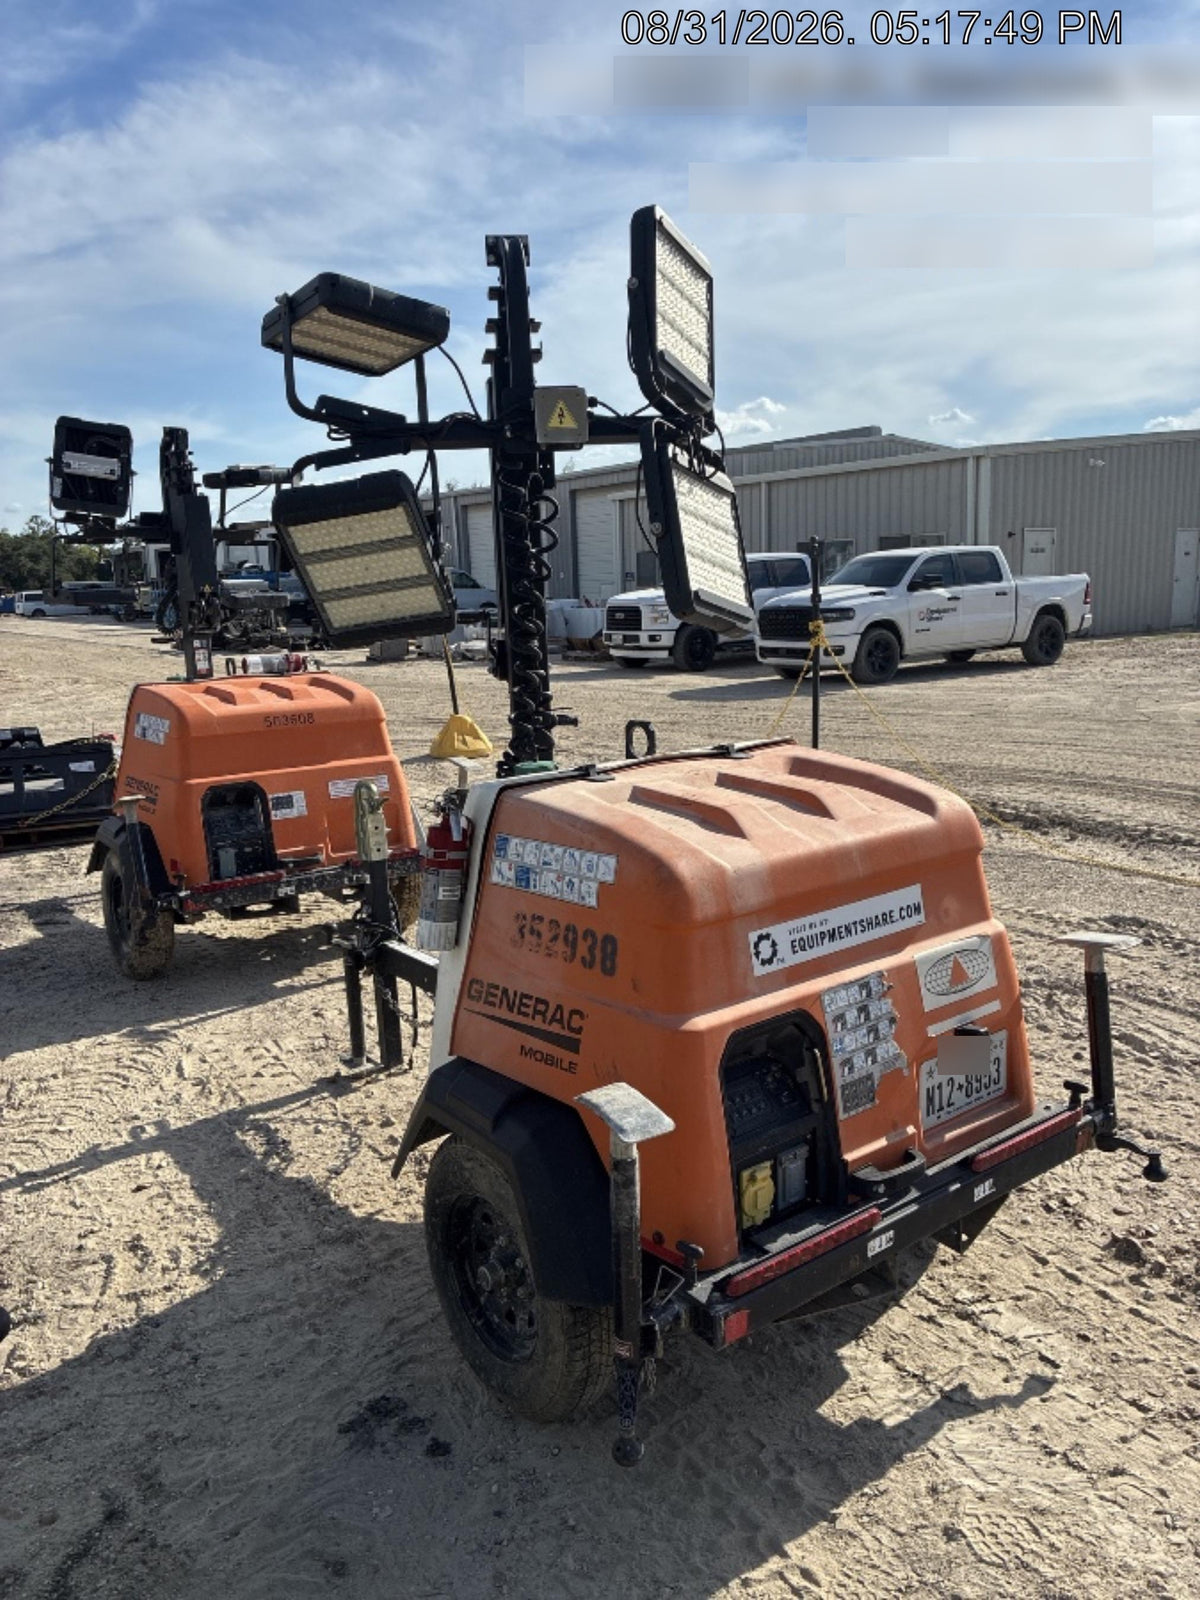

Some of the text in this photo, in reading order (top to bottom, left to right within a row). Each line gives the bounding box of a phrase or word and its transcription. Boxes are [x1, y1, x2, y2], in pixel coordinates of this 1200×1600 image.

[789, 901, 922, 956] EQUIPMENTSHARE.COM
[466, 977, 585, 1036] GENERAC
[519, 1044, 579, 1075] MOBILE
